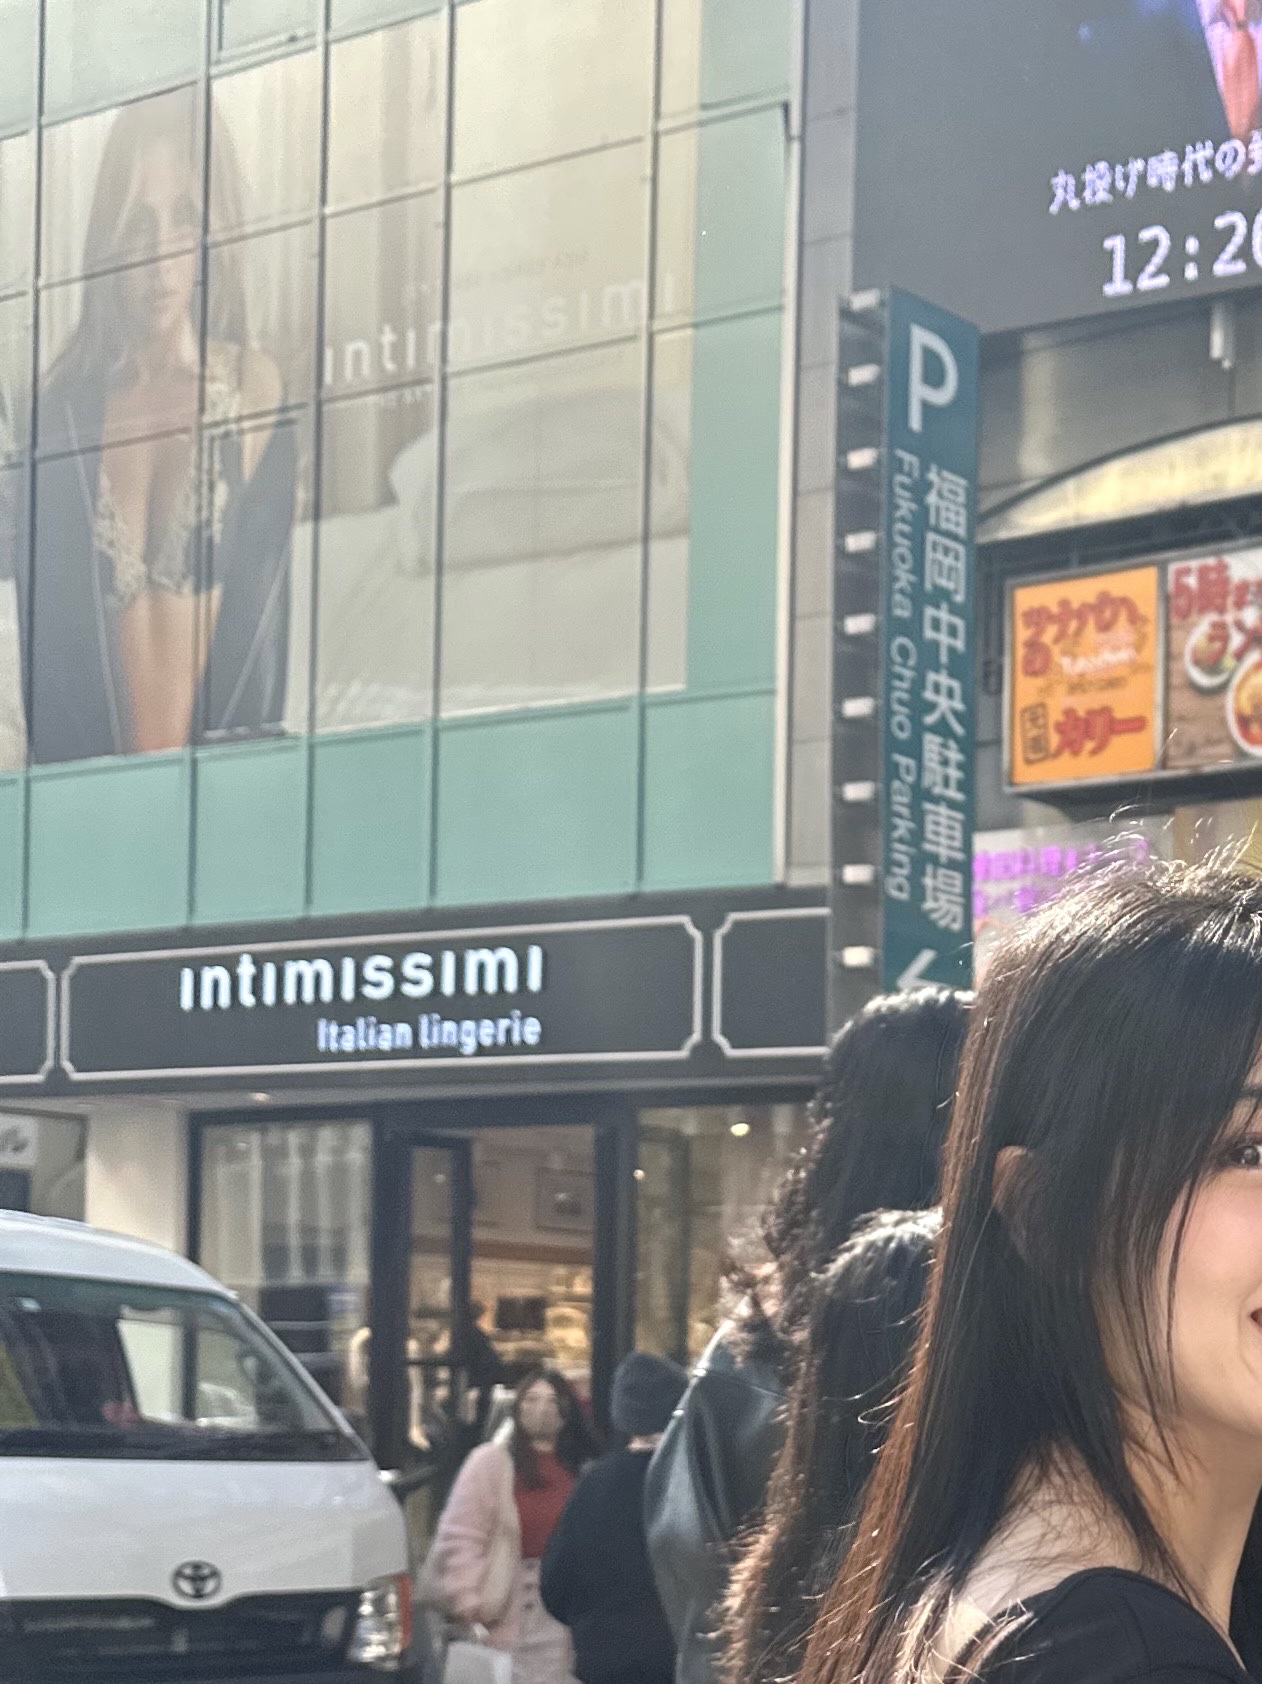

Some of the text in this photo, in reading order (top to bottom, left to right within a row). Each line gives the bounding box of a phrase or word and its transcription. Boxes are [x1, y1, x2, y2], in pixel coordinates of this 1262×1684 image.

[907, 322, 960, 434] P
[884, 448, 921, 902] Fukuoka Chuo Parking
[922, 463, 970, 933] 福岡中央駐車場
[180, 945, 543, 1012] intimissimi
[316, 1009, 543, 1056] Italian lingerie
